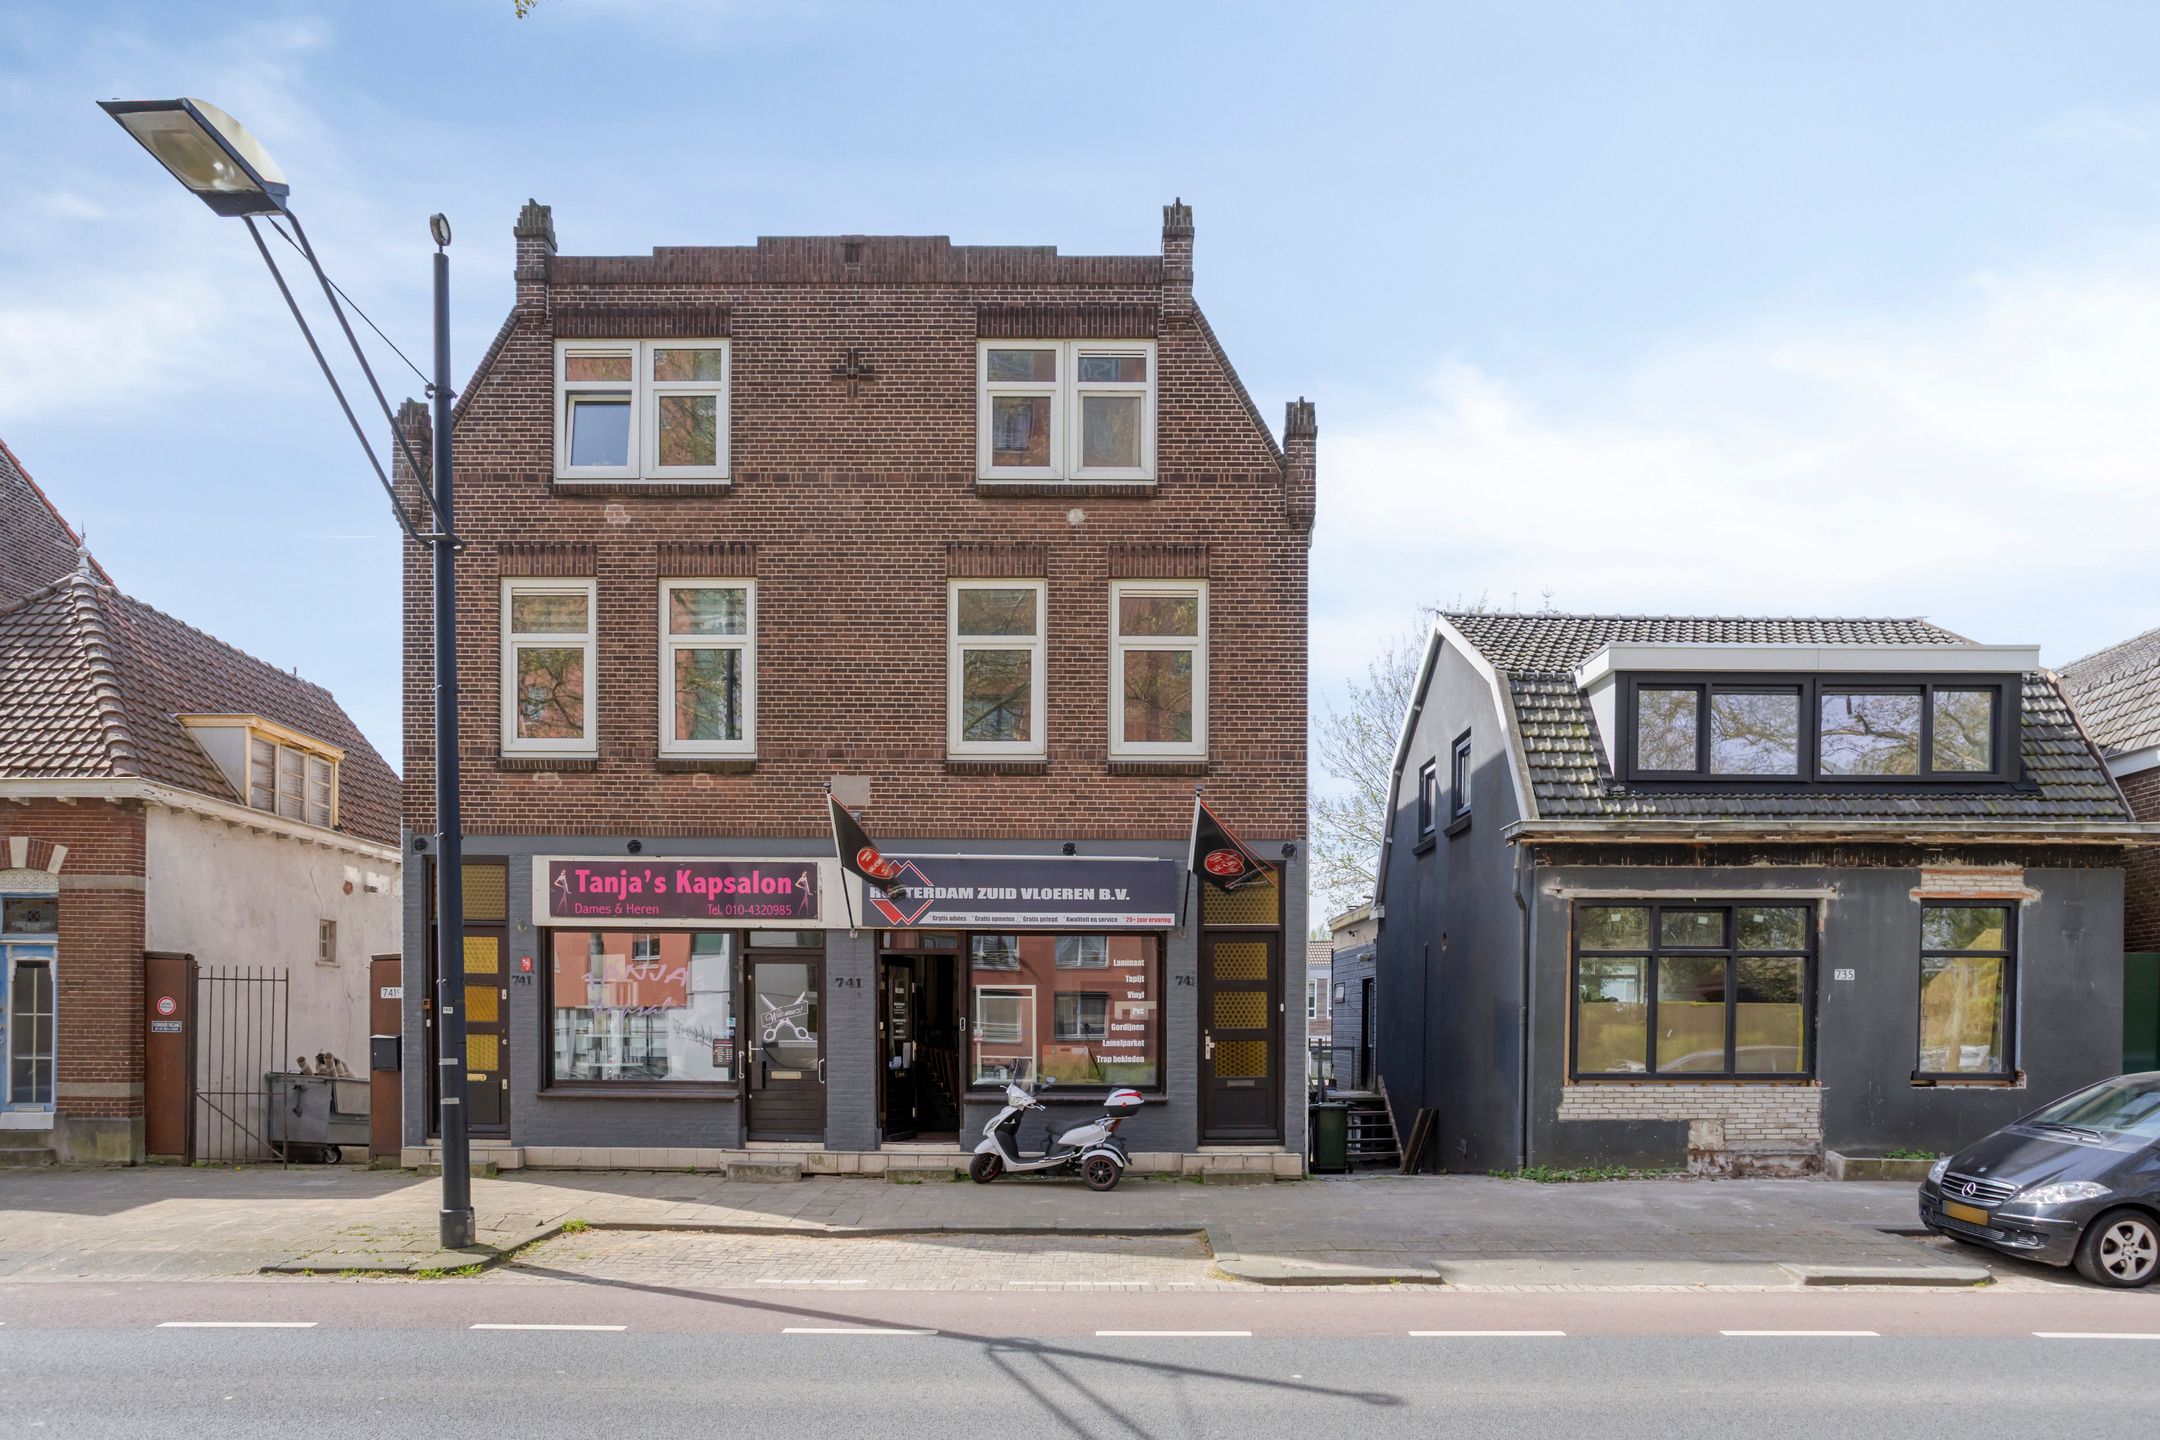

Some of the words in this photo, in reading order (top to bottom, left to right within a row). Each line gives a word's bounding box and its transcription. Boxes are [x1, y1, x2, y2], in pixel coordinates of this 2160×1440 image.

[575, 868, 667, 900] Tanja's
[676, 870, 792, 901] Kapsalon
[870, 887, 973, 899] RTERDAM
[977, 888, 1017, 899] ZUID
[1021, 888, 1094, 900] VLOEREN
[1099, 888, 1130, 900] B.V.
[575, 903, 611, 914] Dames
[615, 903, 622, 914] &
[626, 903, 659, 914] Heren
[707, 904, 722, 915] Tel.
[725, 905, 792, 916] 010-4320985
[1113, 959, 1145, 967] Laminaat
[512, 975, 532, 986] 741
[835, 977, 862, 988] 741
[1125, 975, 1145, 983] Tapijt
[1127, 991, 1145, 999] Vinyl
[1111, 1023, 1145, 1031] Gordijnen
[1102, 1039, 1145, 1047] Lamelparket
[1096, 1055, 1112, 1064] Trap
[1112, 1055, 1145, 1063] bekleden
